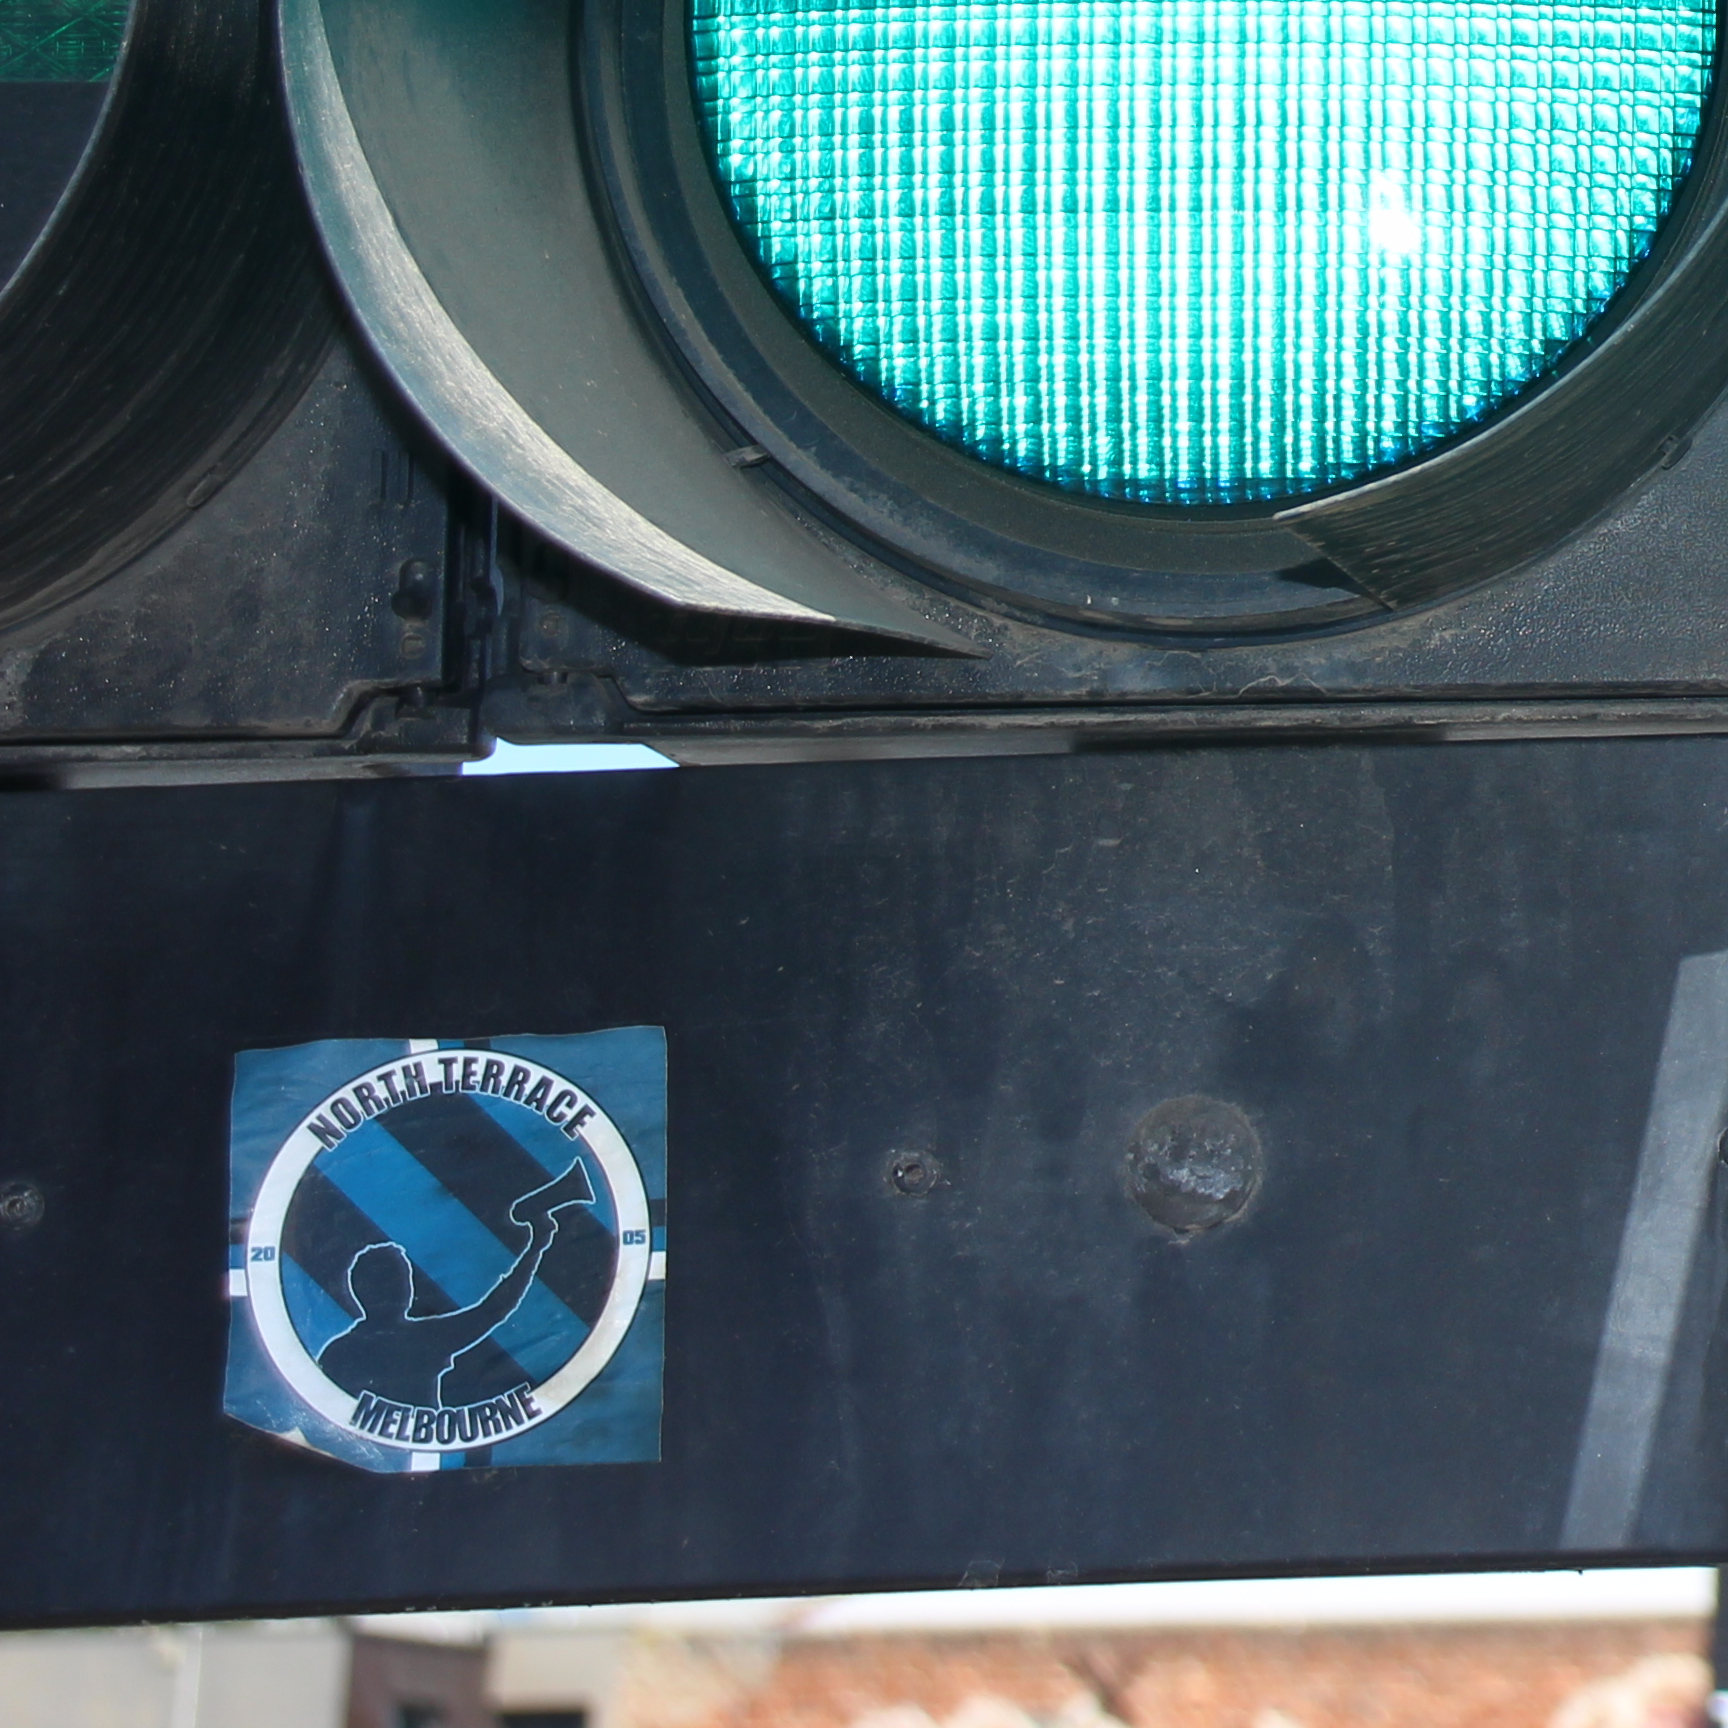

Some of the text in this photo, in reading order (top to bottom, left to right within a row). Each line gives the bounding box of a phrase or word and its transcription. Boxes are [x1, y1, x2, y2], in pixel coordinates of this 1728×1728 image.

[306, 1054, 597, 1152] NORTH TERRACE
[250, 1228, 648, 1264] 20 05
[347, 1381, 543, 1445] MELBOURNE
